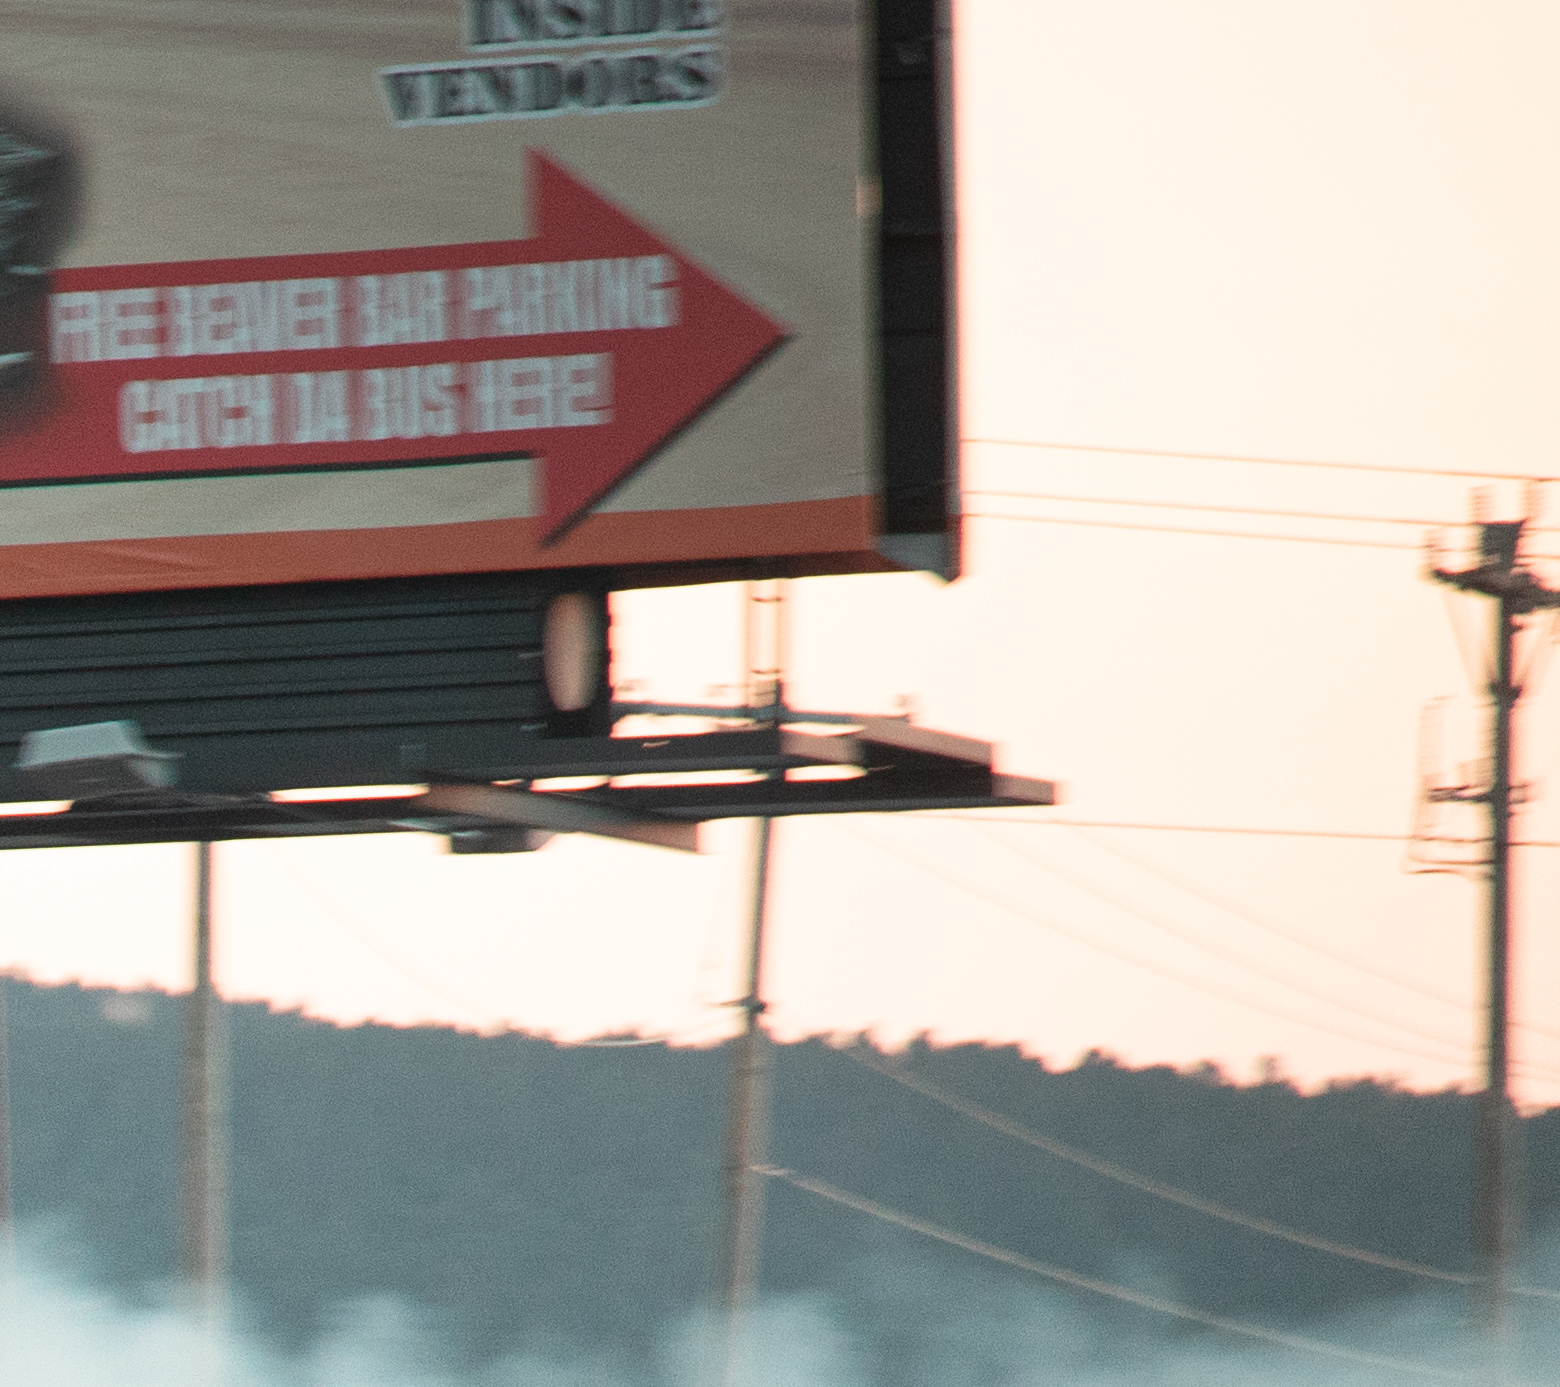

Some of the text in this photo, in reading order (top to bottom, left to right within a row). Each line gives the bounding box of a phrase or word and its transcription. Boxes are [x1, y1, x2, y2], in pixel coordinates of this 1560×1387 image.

[470, 0, 717, 46] INSIDE
[382, 50, 718, 121] VENDORS
[352, 267, 451, 348] BAR
[458, 253, 682, 342] PARKING
[118, 370, 277, 454] CATCH
[361, 359, 469, 439] BUS
